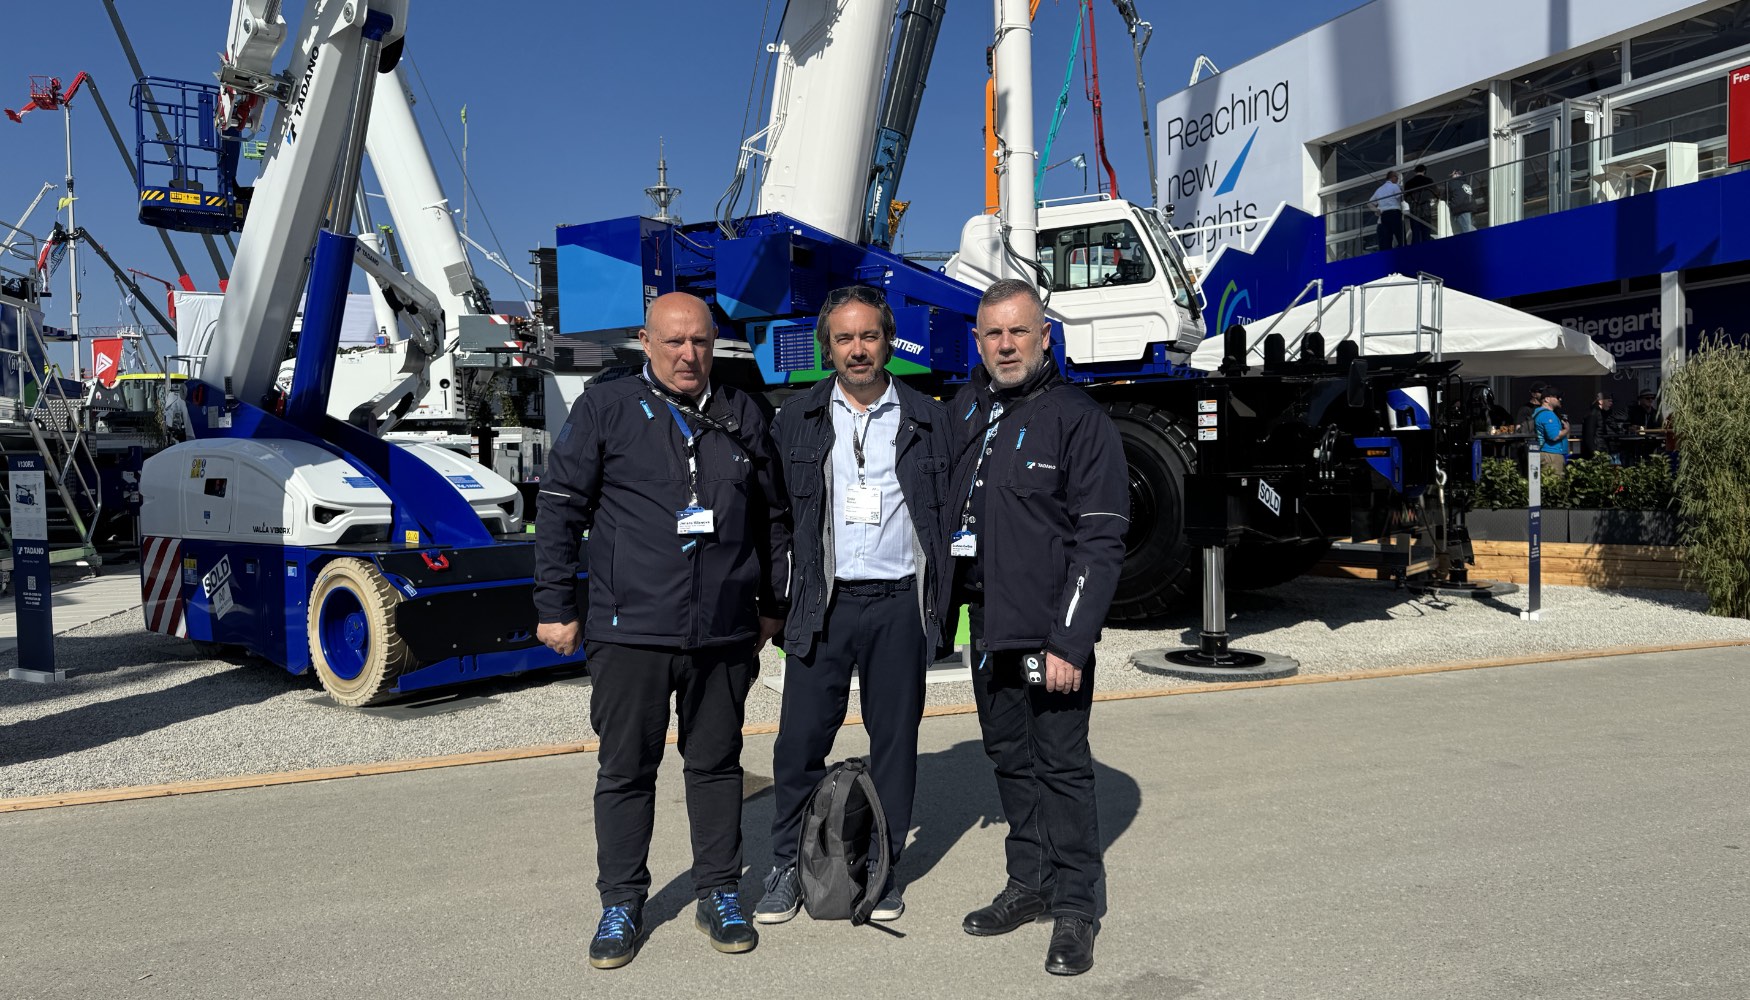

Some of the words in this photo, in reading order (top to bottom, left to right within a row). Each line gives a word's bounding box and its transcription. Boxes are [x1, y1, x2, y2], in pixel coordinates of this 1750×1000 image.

[294, 46, 320, 117] TADANO
[1168, 80, 1289, 155] Reaching
[1168, 160, 1217, 203] new
[1561, 307, 1694, 339] Biergartn
[1260, 483, 1280, 512] SOLD
[204, 558, 230, 594] SOLD
